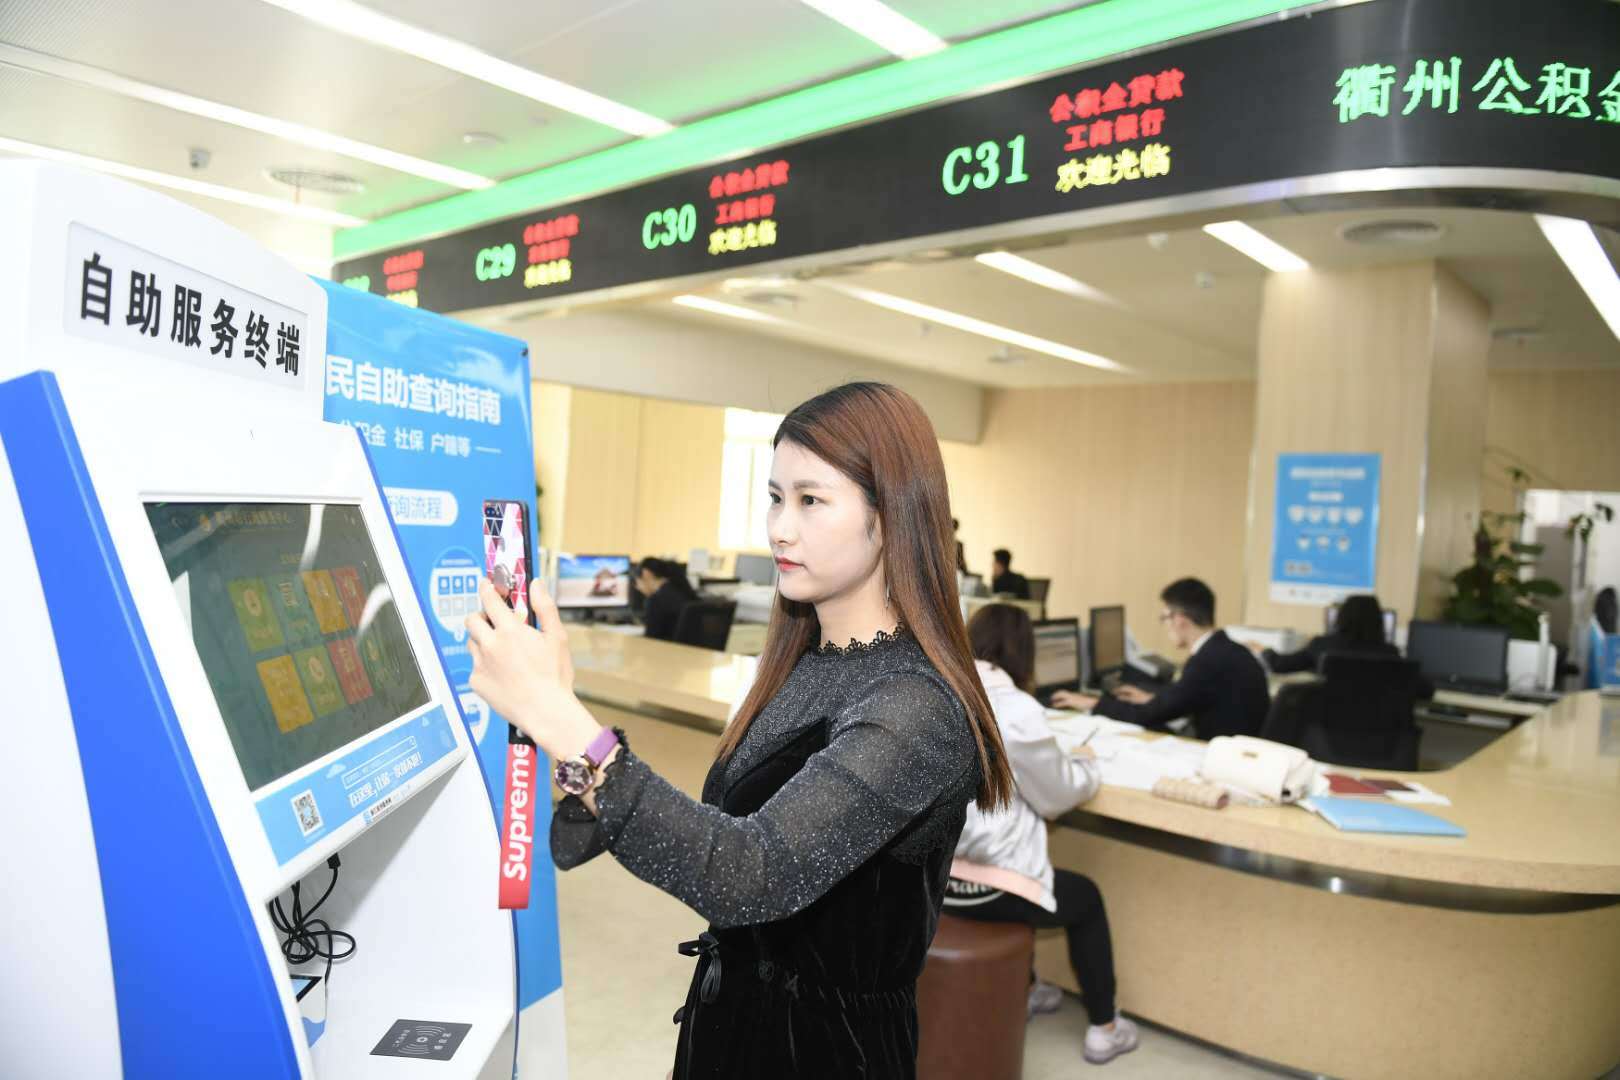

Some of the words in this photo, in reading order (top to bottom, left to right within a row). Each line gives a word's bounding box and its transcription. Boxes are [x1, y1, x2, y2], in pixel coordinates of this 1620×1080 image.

[942, 134, 1029, 195] C31
[1055, 143, 1171, 193] 欢迎光临
[642, 204, 697, 250] C30
[475, 243, 516, 281] C29
[80, 253, 300, 376] 自助服务终端
[326, 354, 501, 426] 民自助查询指南
[394, 426, 424, 451] 社保
[387, 495, 442, 519] 询流程
[503, 743, 531, 881] Supreme
